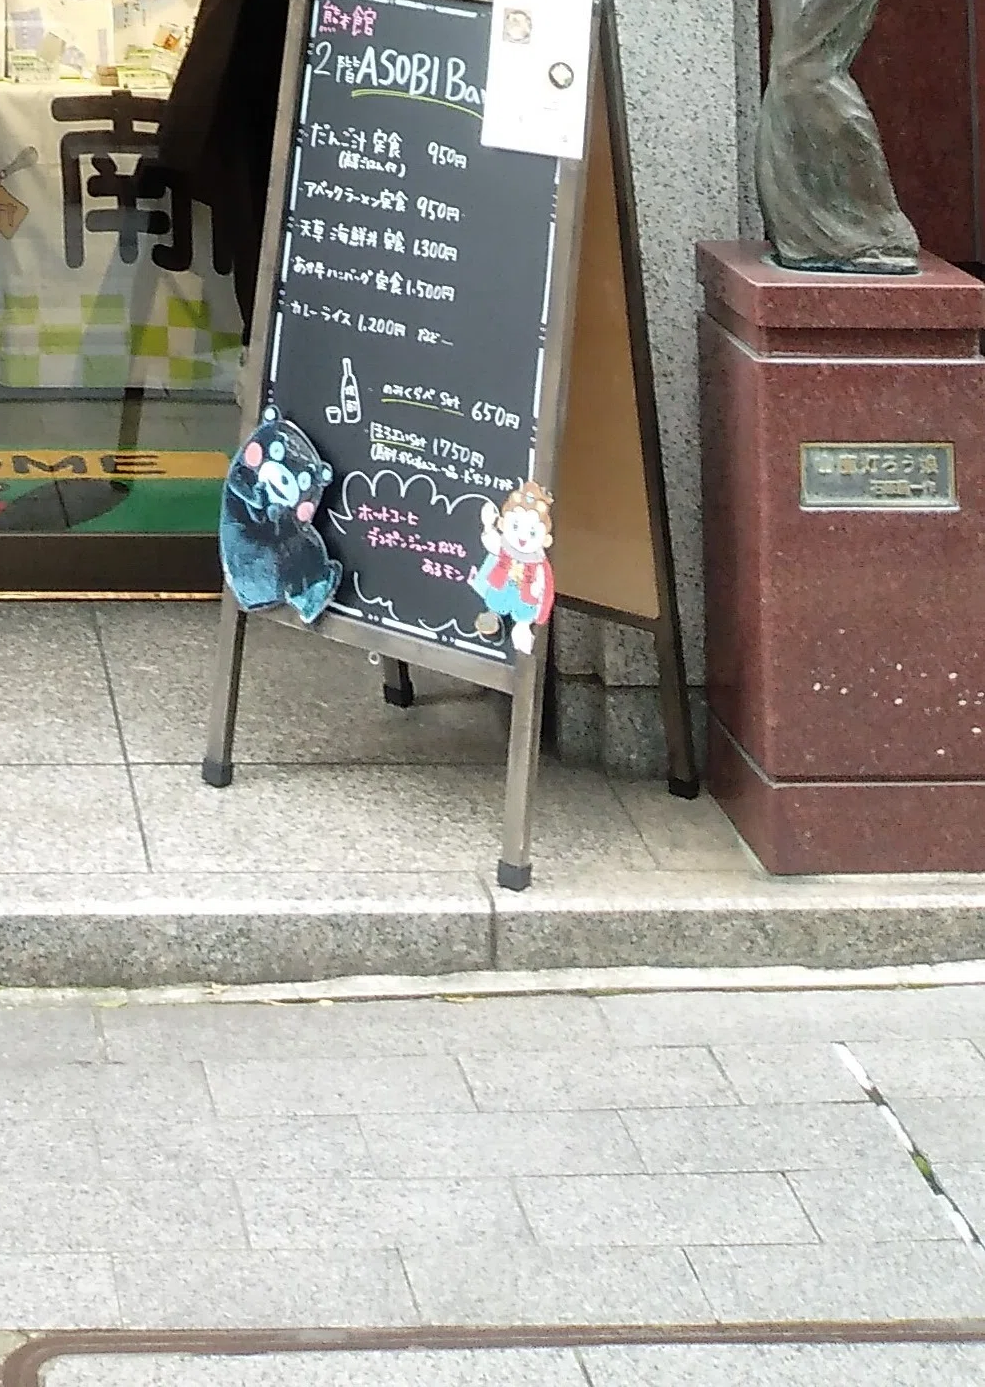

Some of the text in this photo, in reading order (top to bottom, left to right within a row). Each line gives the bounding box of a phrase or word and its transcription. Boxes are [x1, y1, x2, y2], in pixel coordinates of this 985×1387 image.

[319, 0, 378, 37] 熊本館
[427, 141, 468, 170] 950円
[417, 195, 461, 223] 950円
[471, 400, 521, 430] 650円
